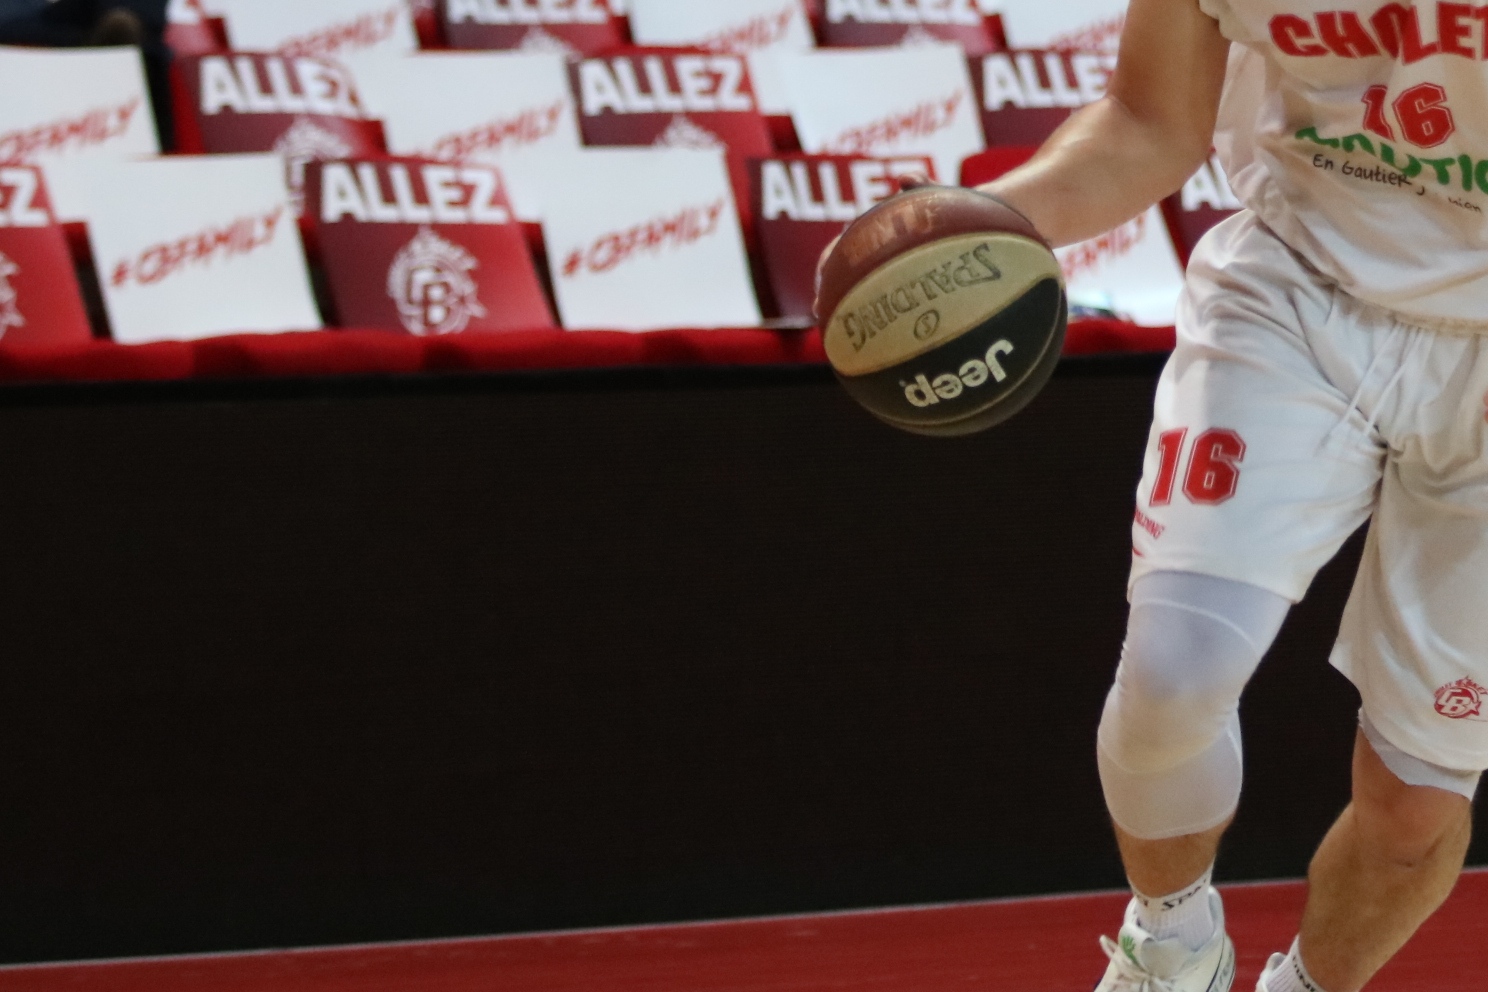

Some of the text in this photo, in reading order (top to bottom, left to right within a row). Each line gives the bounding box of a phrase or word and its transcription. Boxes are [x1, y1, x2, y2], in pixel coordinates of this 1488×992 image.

[578, 55, 748, 113] ALLEZ
[984, 53, 1117, 108] ALLE
[1361, 82, 1456, 149] 16
[322, 161, 509, 223] ALLEZ
[1313, 153, 1334, 171] En
[841, 243, 1003, 354] SPALDING
[903, 339, 1015, 408] Jeep
[1149, 426, 1246, 507] 16
